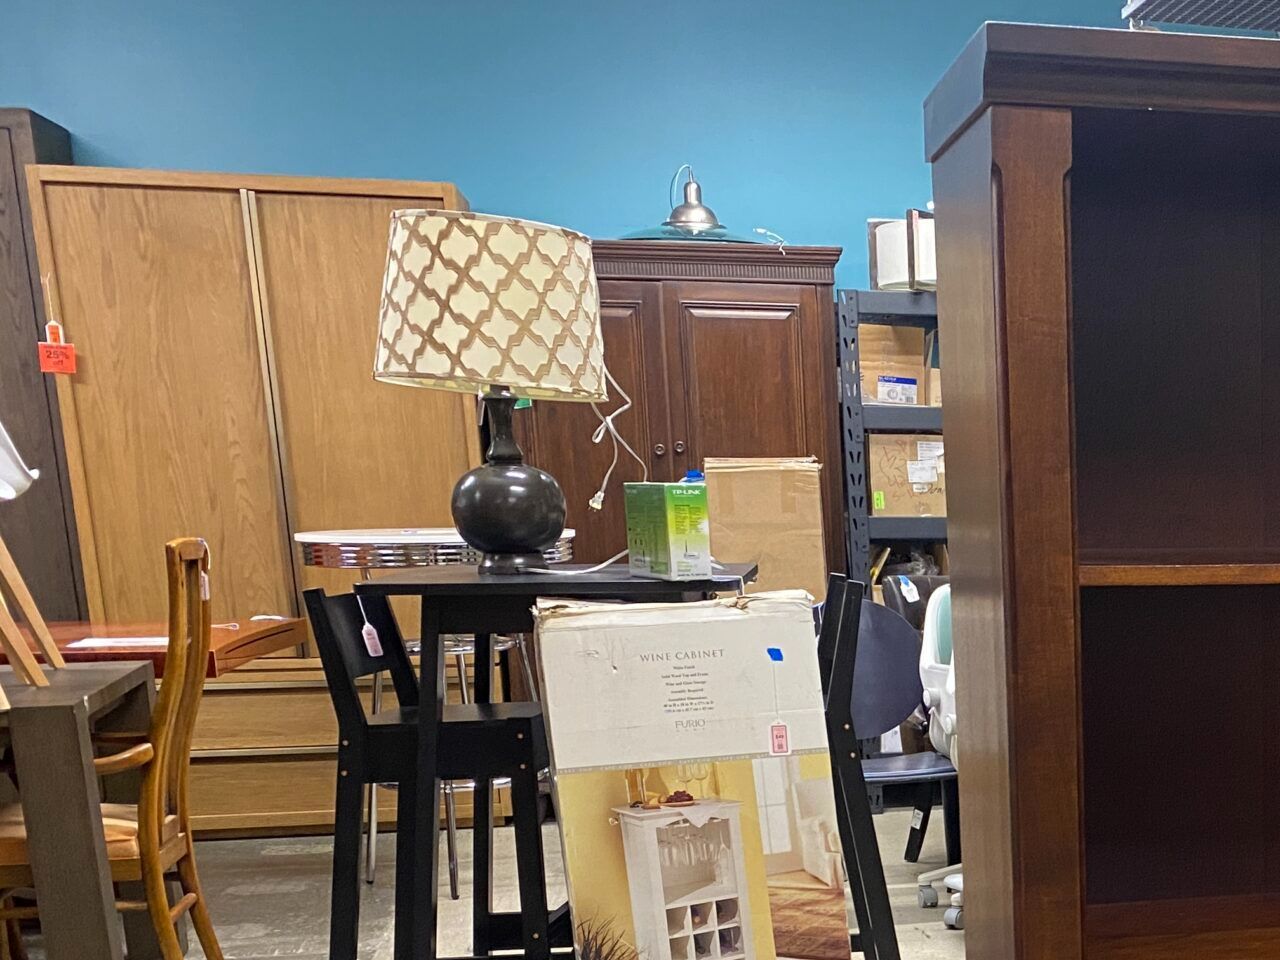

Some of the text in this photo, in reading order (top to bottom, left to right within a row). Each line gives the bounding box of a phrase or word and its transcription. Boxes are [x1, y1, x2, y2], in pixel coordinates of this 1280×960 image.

[46, 350, 70, 359] 25%
[640, 649, 724, 662] WINE CABINET
[675, 719, 706, 728] FURIO
